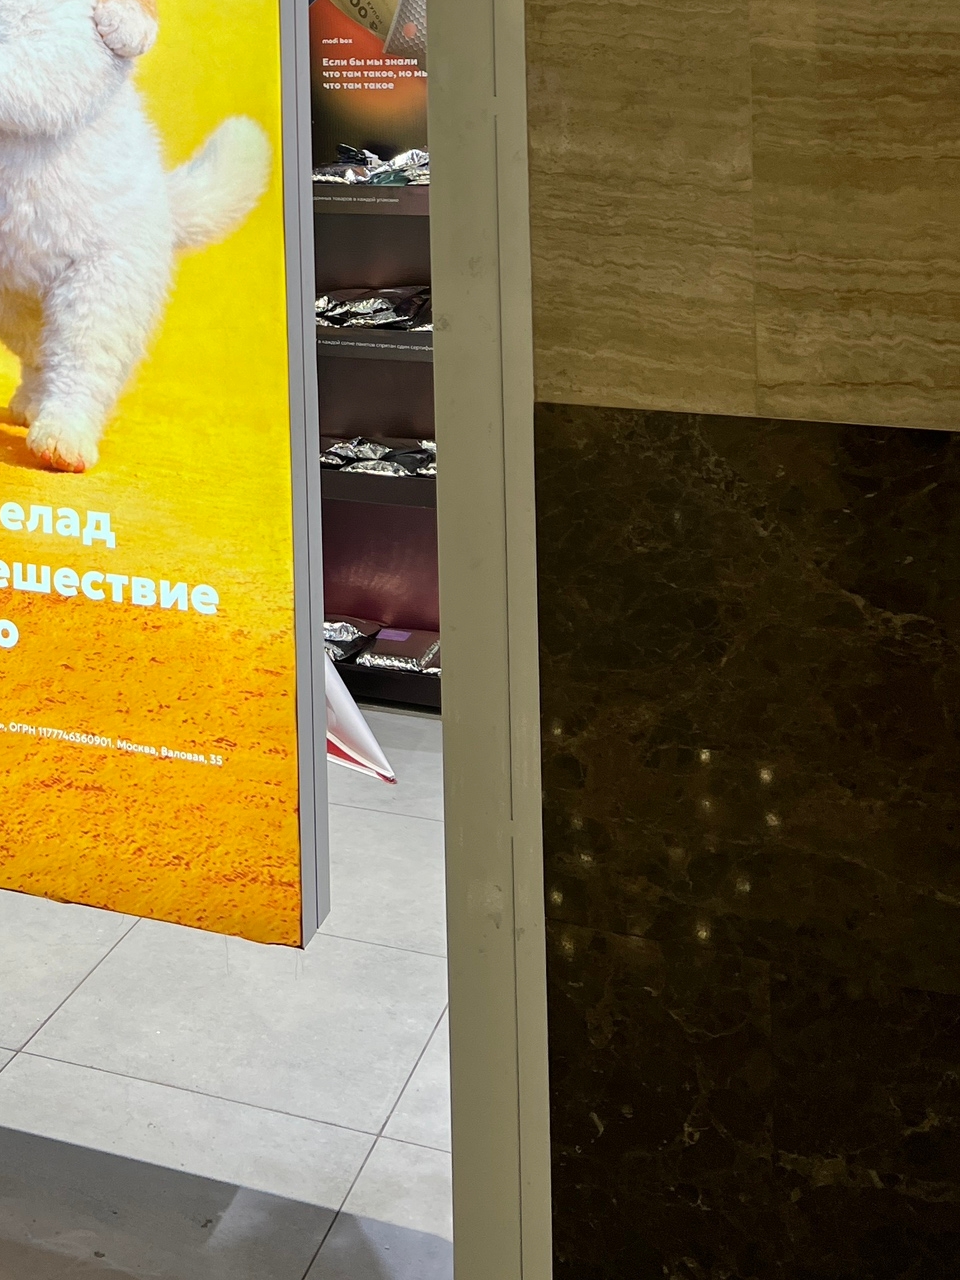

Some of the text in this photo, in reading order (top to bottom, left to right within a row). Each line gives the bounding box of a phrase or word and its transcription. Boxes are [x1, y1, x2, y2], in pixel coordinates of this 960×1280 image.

[322, 57, 418, 66] Если бы мы знали
[363, 70, 396, 79] такое,
[9, 721, 36, 736] ОГРН
[116, 740, 159, 757] Москва,
[161, 746, 207, 764] Валовая,
[209, 754, 223, 766] 35
